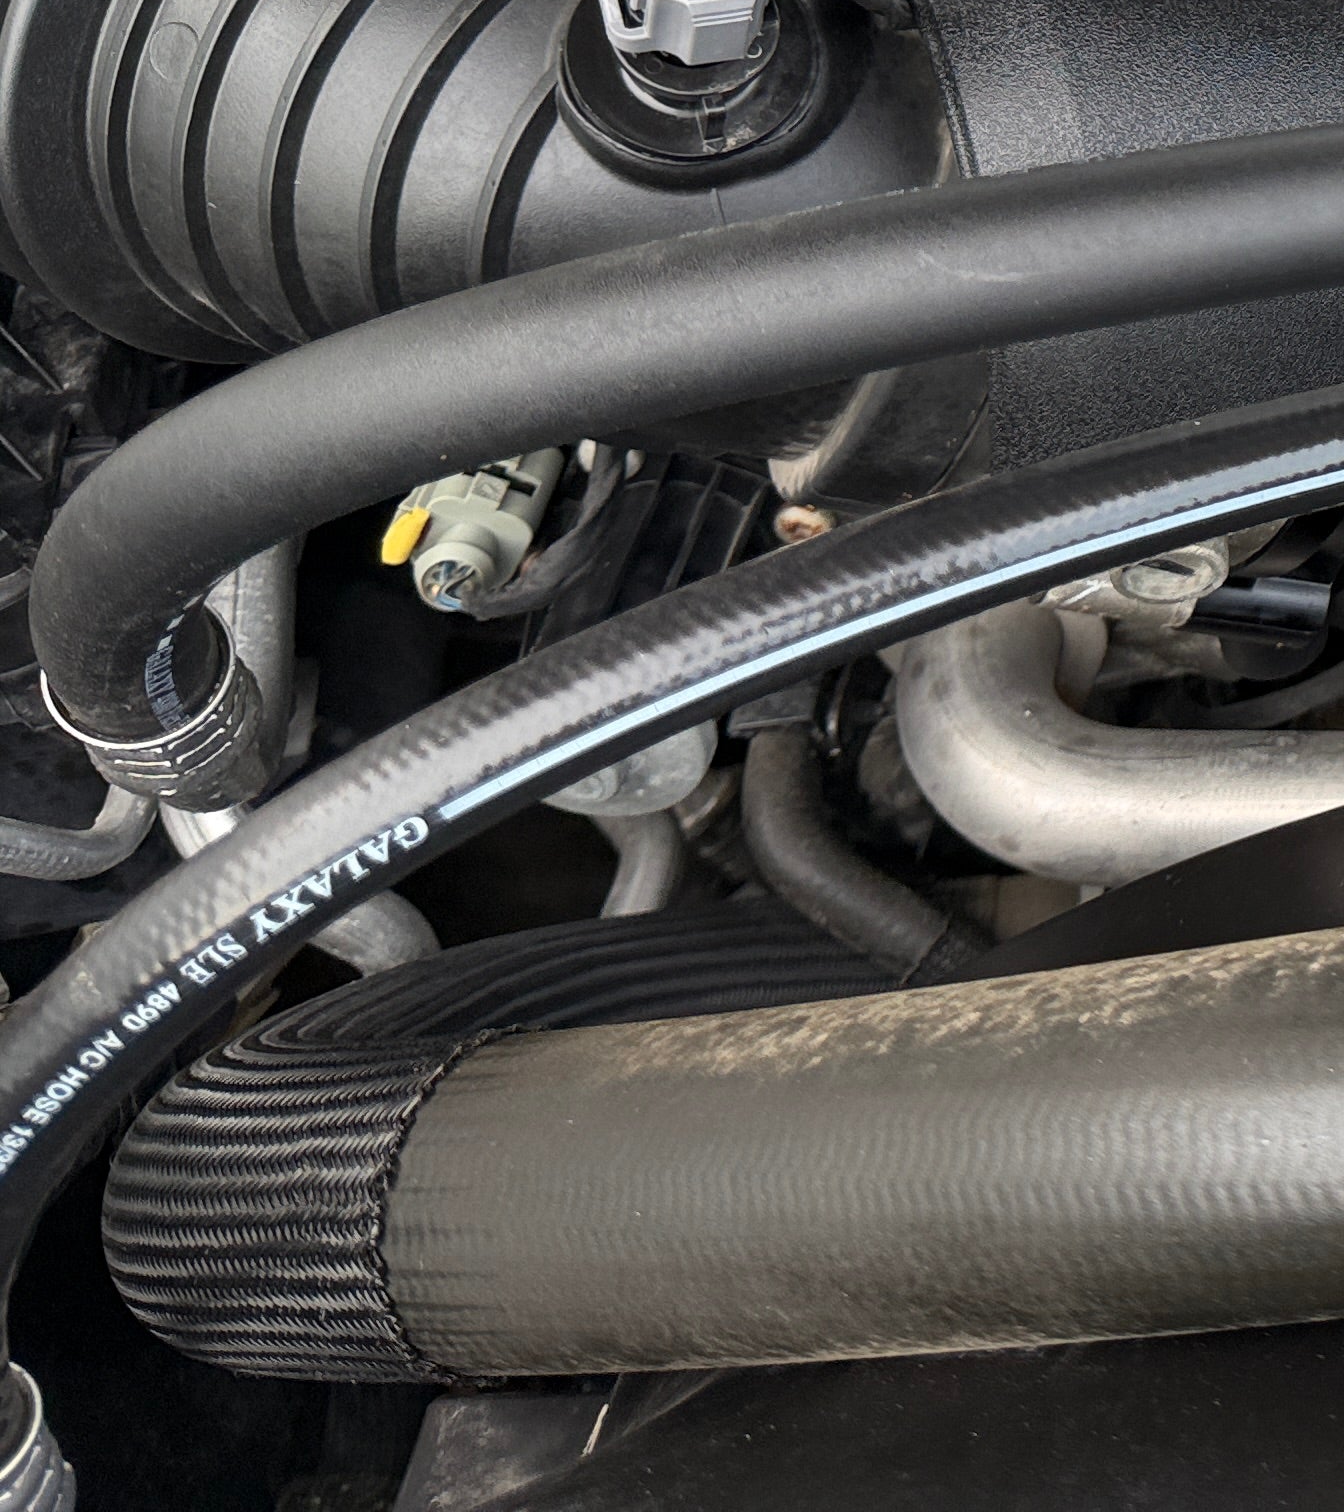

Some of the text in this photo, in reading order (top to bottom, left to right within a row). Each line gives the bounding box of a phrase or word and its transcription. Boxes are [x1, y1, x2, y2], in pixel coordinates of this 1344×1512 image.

[249, 816, 430, 944] GALAXY
[180, 932, 249, 987] SLE
[121, 980, 183, 1034] 4890
[79, 1025, 127, 1074] A/C
[22, 1064, 92, 1134] HOSE
